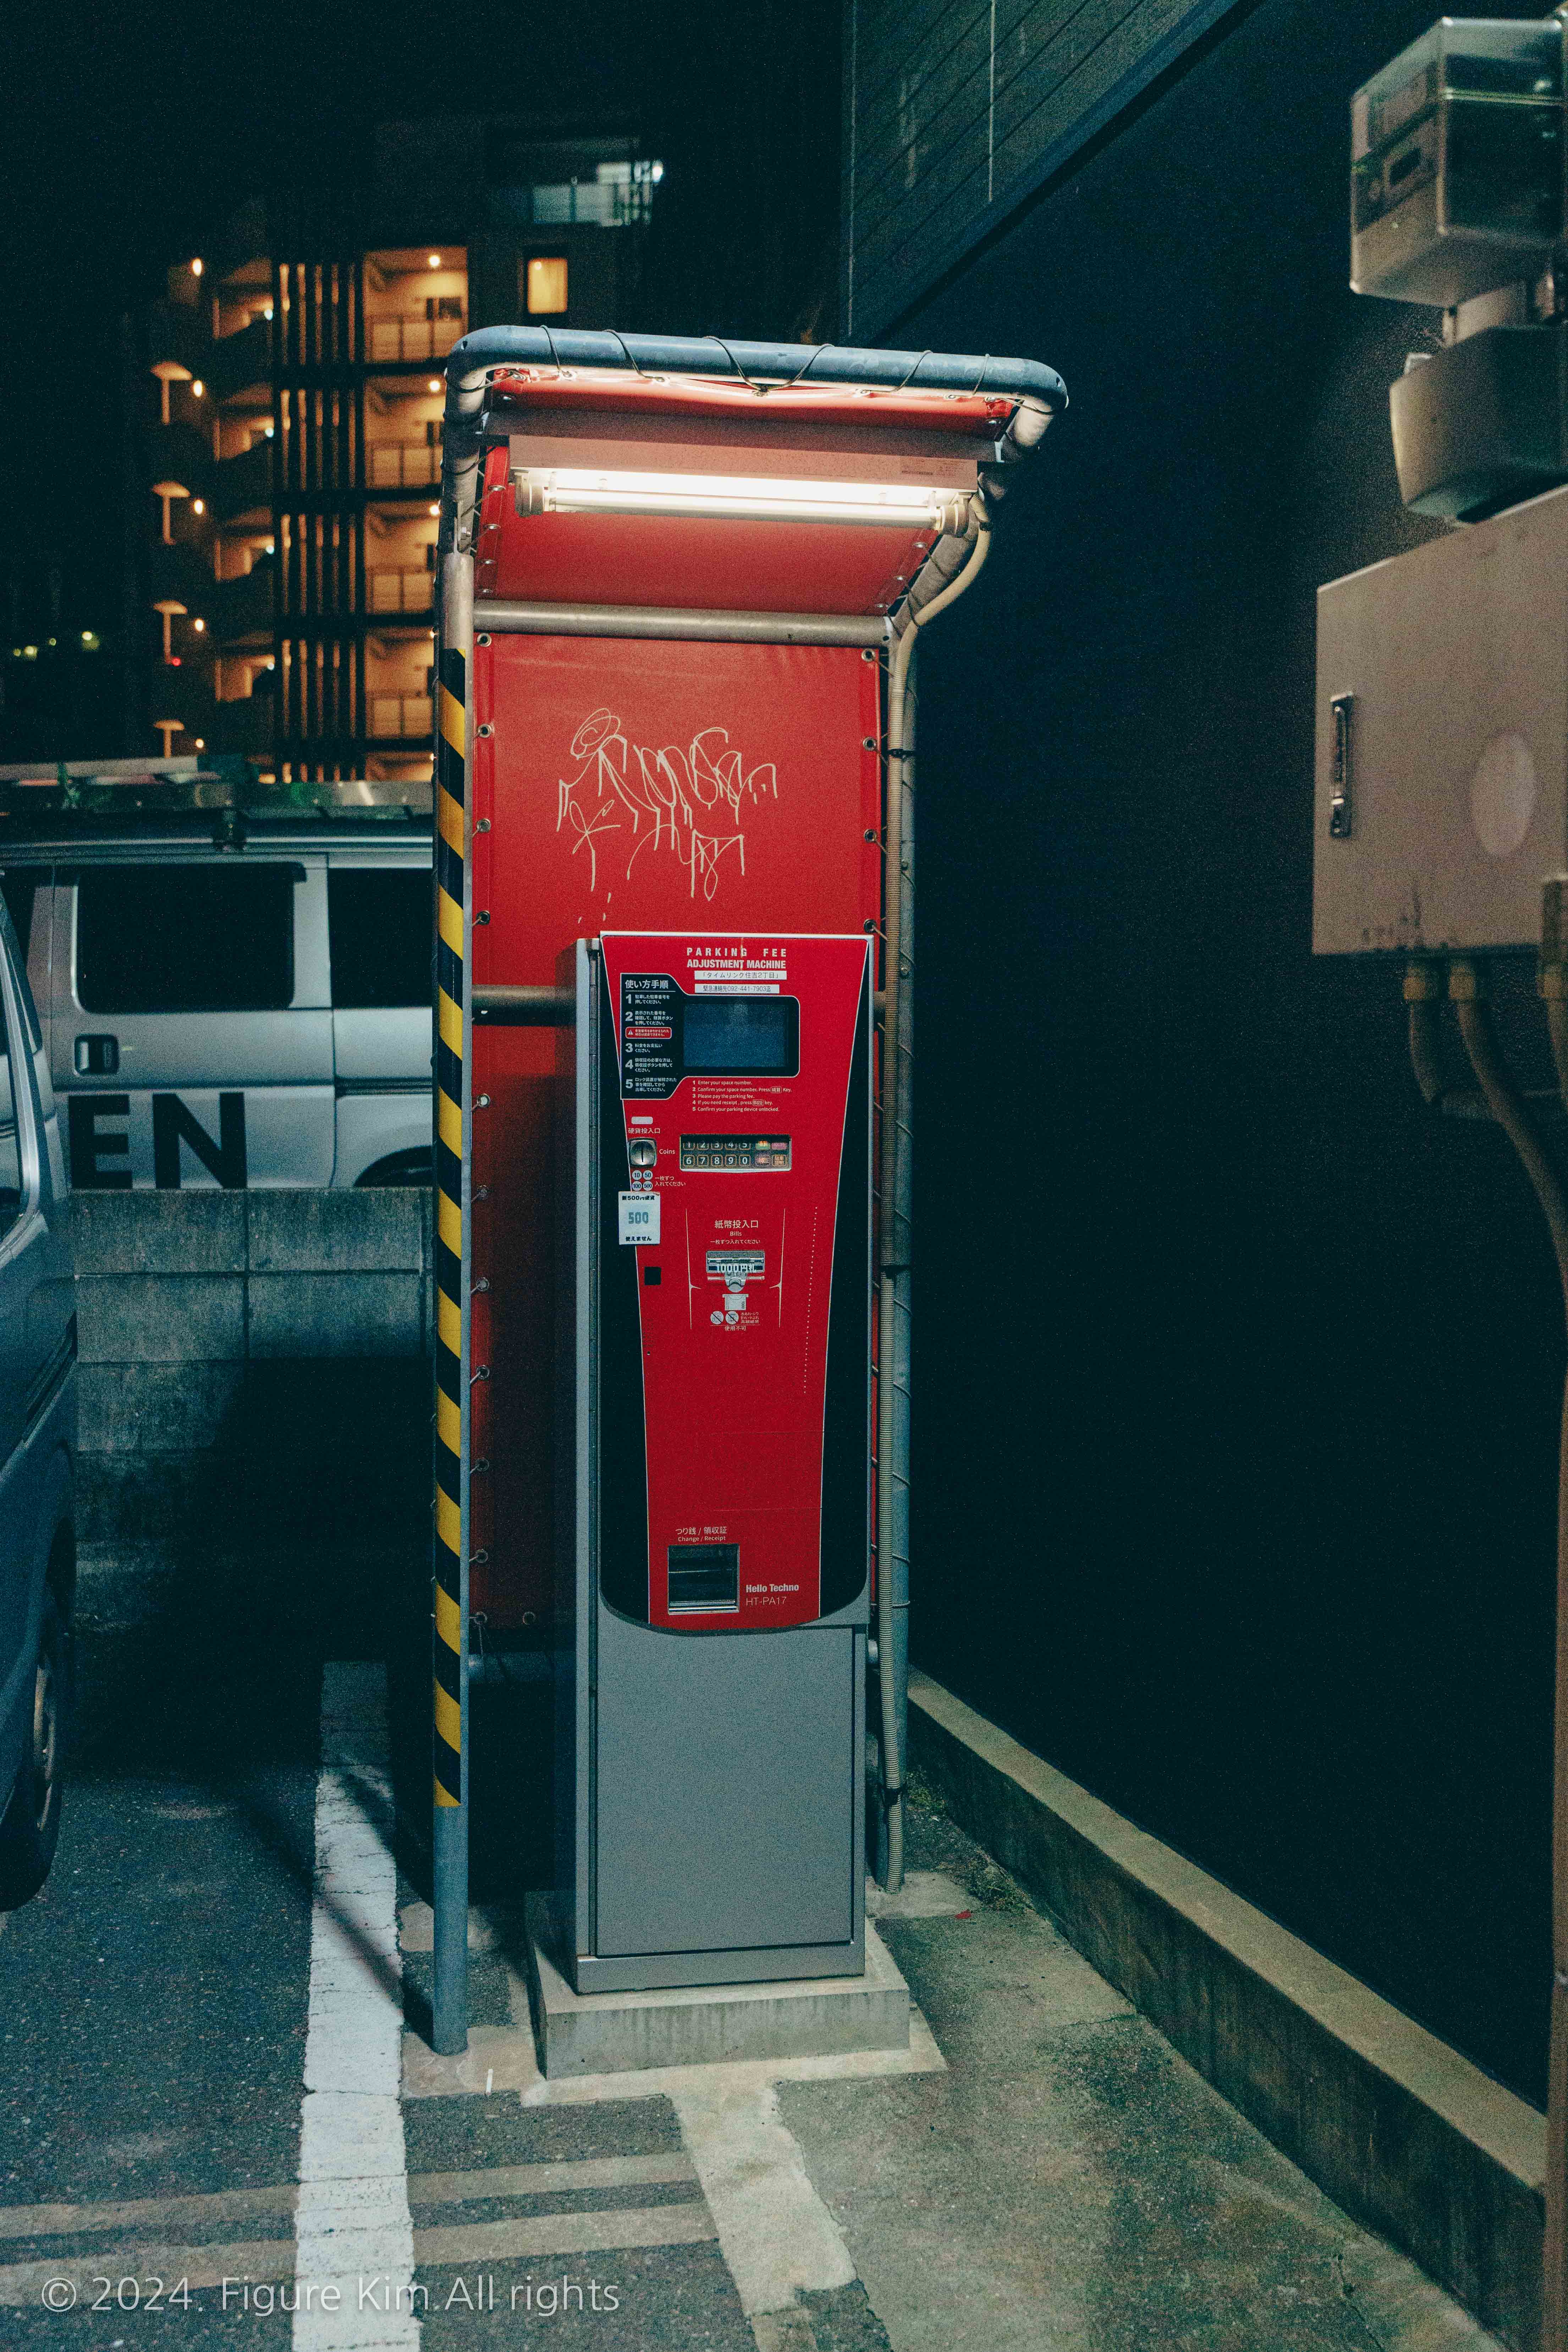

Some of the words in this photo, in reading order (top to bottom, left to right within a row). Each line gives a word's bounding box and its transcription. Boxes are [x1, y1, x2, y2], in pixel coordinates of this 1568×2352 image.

[687, 947, 747, 957] PARKING
[763, 948, 786, 957] FEE
[687, 959, 744, 968] ADJUSTMENT
[747, 960, 786, 969] MACHINE
[625, 980, 669, 989] 使い方手順
[626, 994, 632, 1004] 1
[625, 1011, 633, 1021] 2
[625, 1043, 633, 1053] 3
[625, 1059, 633, 1069] 4
[626, 1079, 633, 1089] 5
[68, 1092, 247, 1189] EN
[628, 1211, 649, 1224] 500
[715, 1220, 758, 1229] 紙幣投入口
[746, 1584, 767, 1593] Hello
[769, 1583, 799, 1592] Techno
[746, 1597, 786, 1606] HT-PA17
